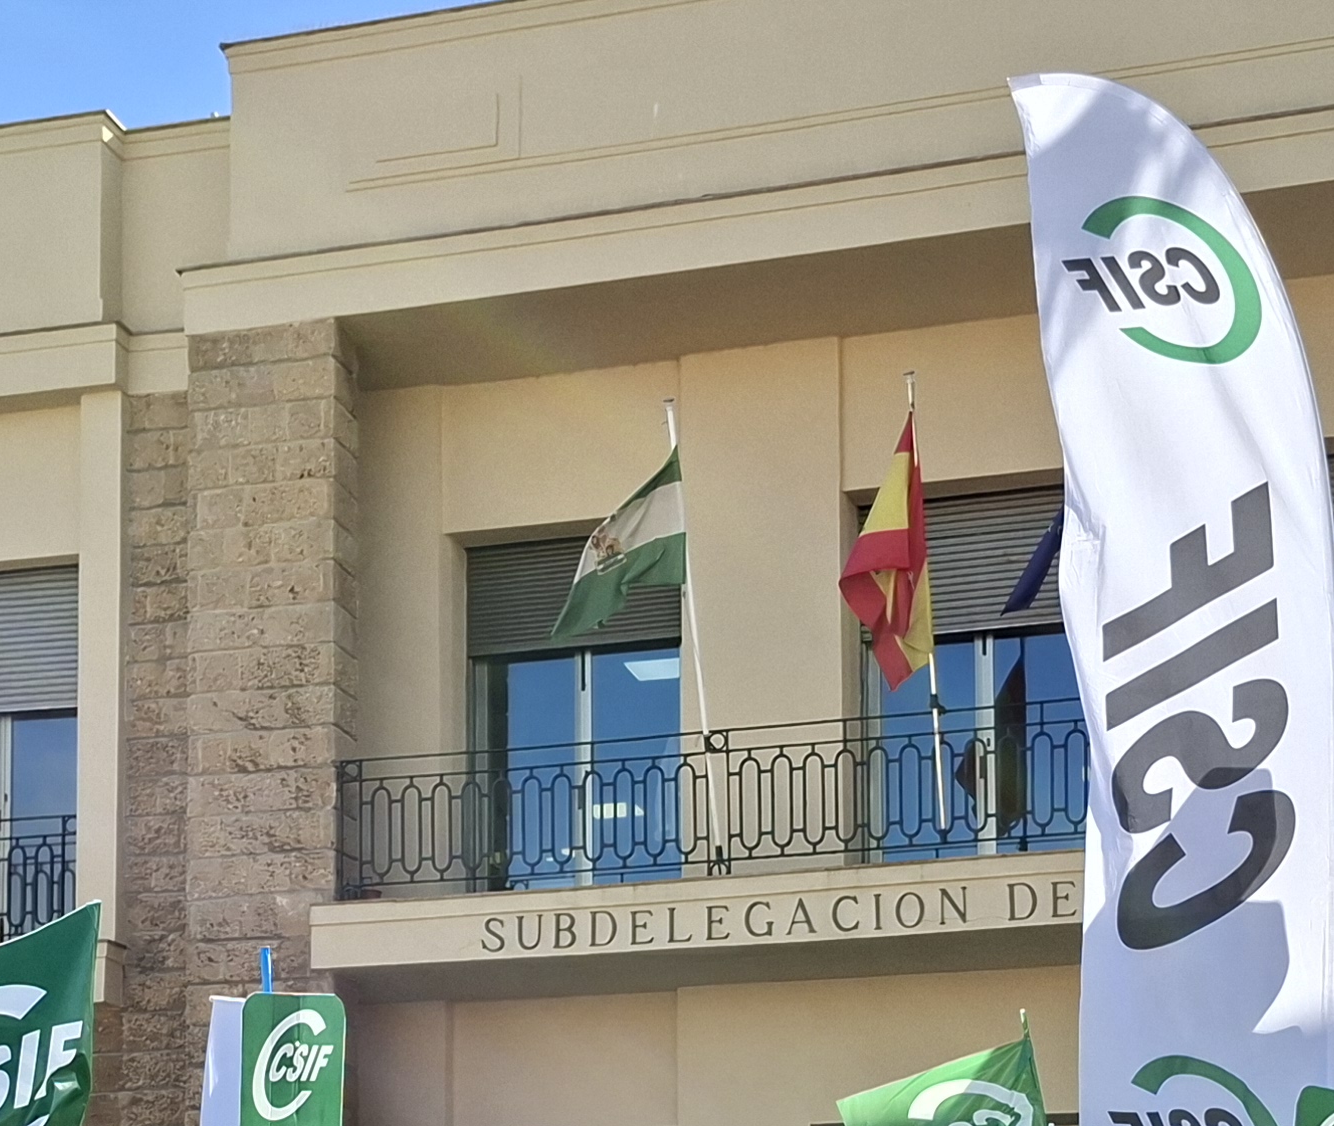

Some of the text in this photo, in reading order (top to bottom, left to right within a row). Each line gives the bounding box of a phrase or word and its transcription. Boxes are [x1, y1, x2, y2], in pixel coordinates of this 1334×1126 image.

[481, 881, 1080, 953] SUBDELEGACION DE
[268, 1041, 334, 1083] CSIF
